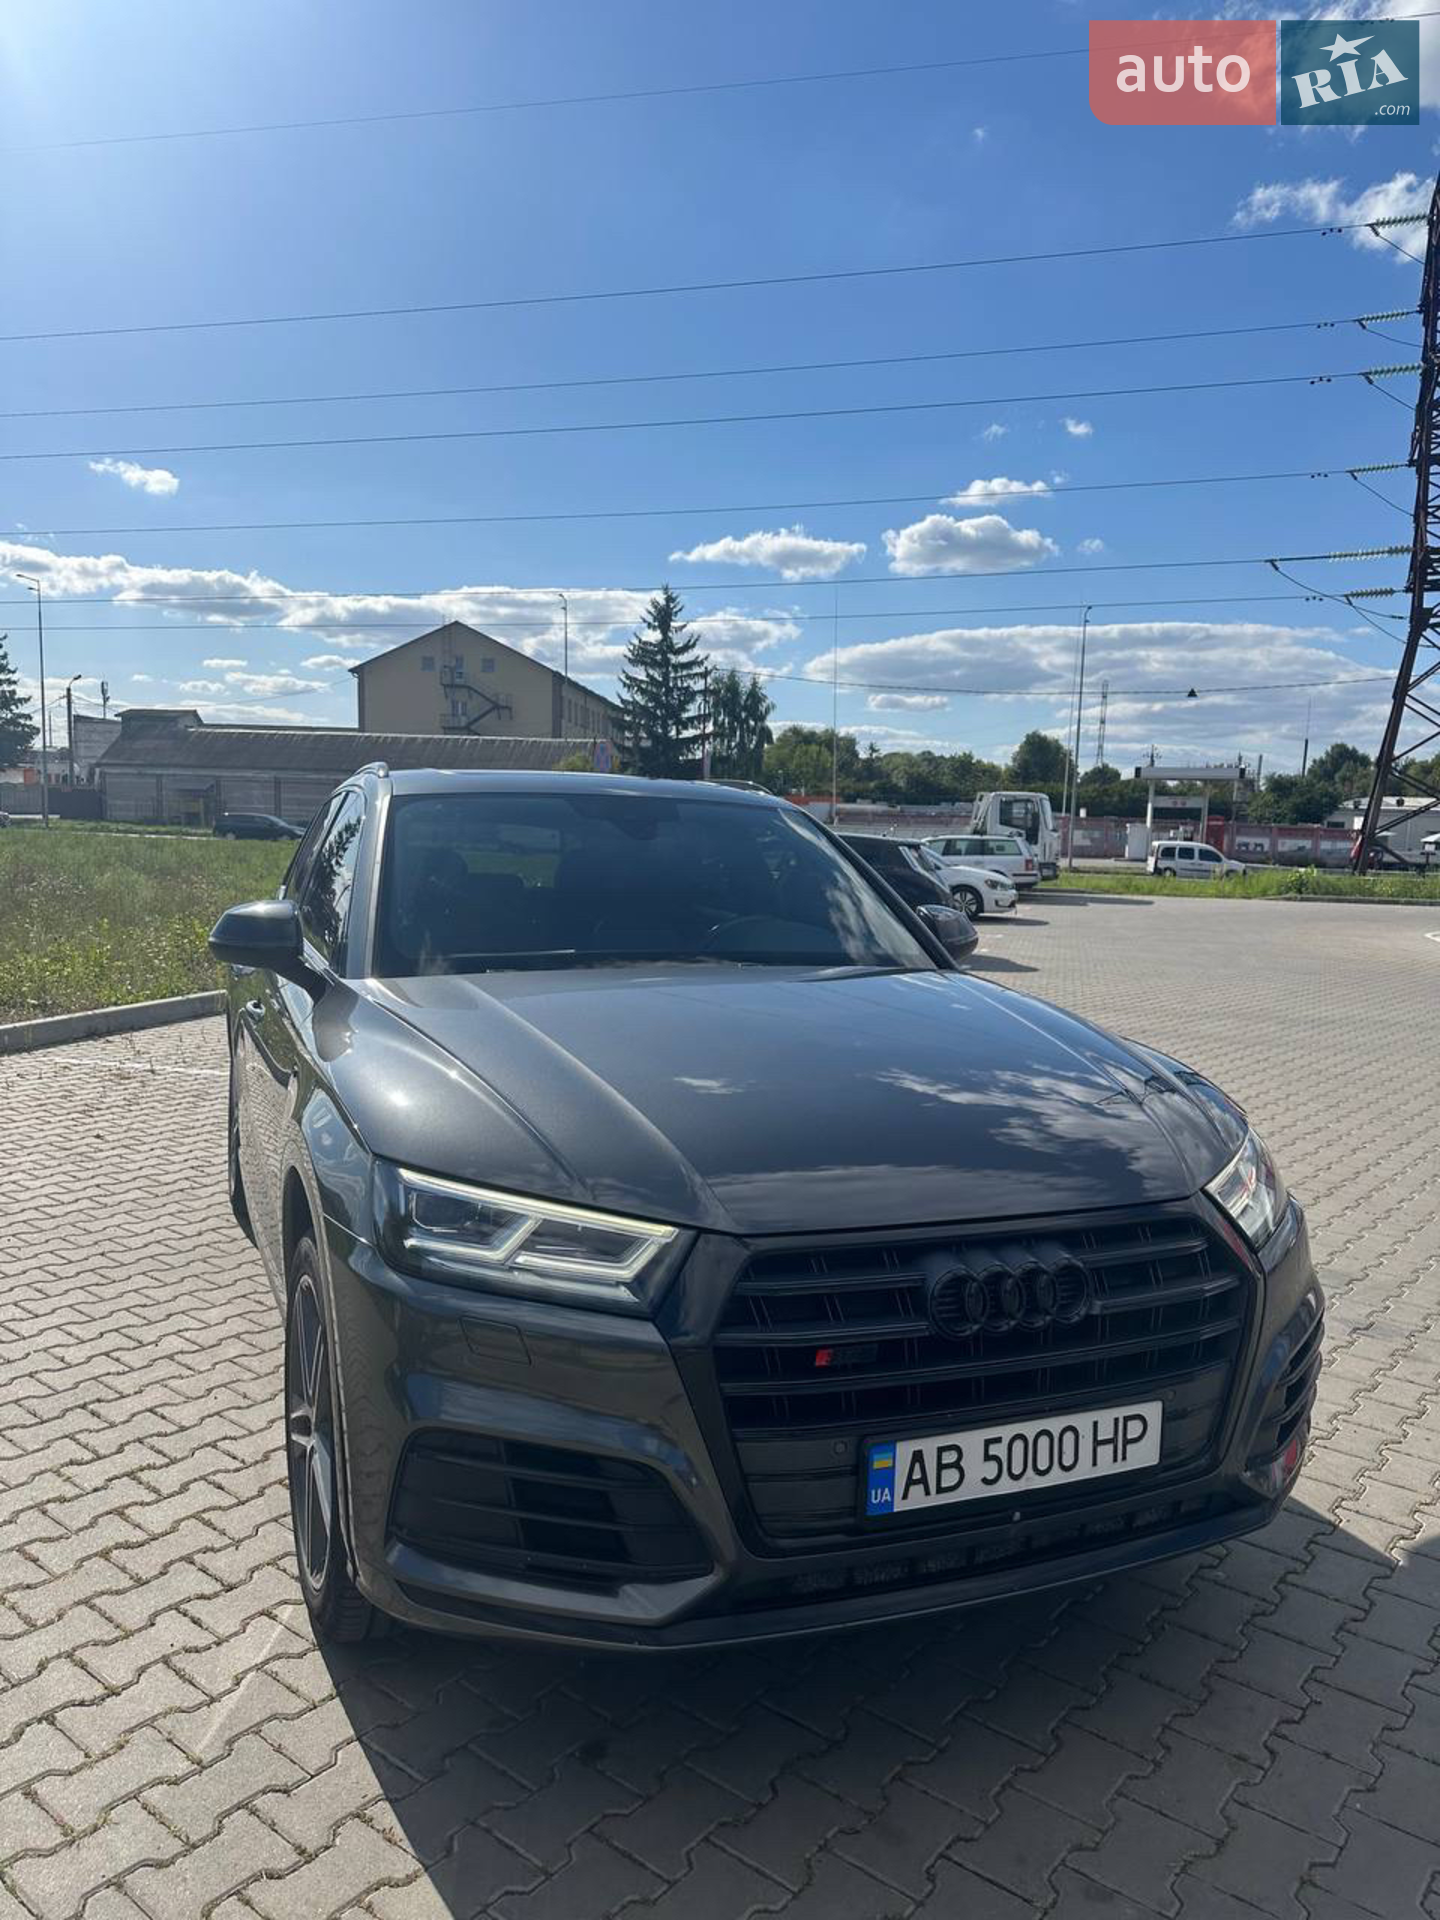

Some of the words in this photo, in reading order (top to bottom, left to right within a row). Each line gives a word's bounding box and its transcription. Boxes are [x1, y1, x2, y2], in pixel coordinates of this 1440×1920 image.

[901, 1443, 966, 1501] AB
[980, 1424, 1080, 1487] 5000
[1091, 1413, 1149, 1468] HP
[870, 1487, 892, 1505] UA
